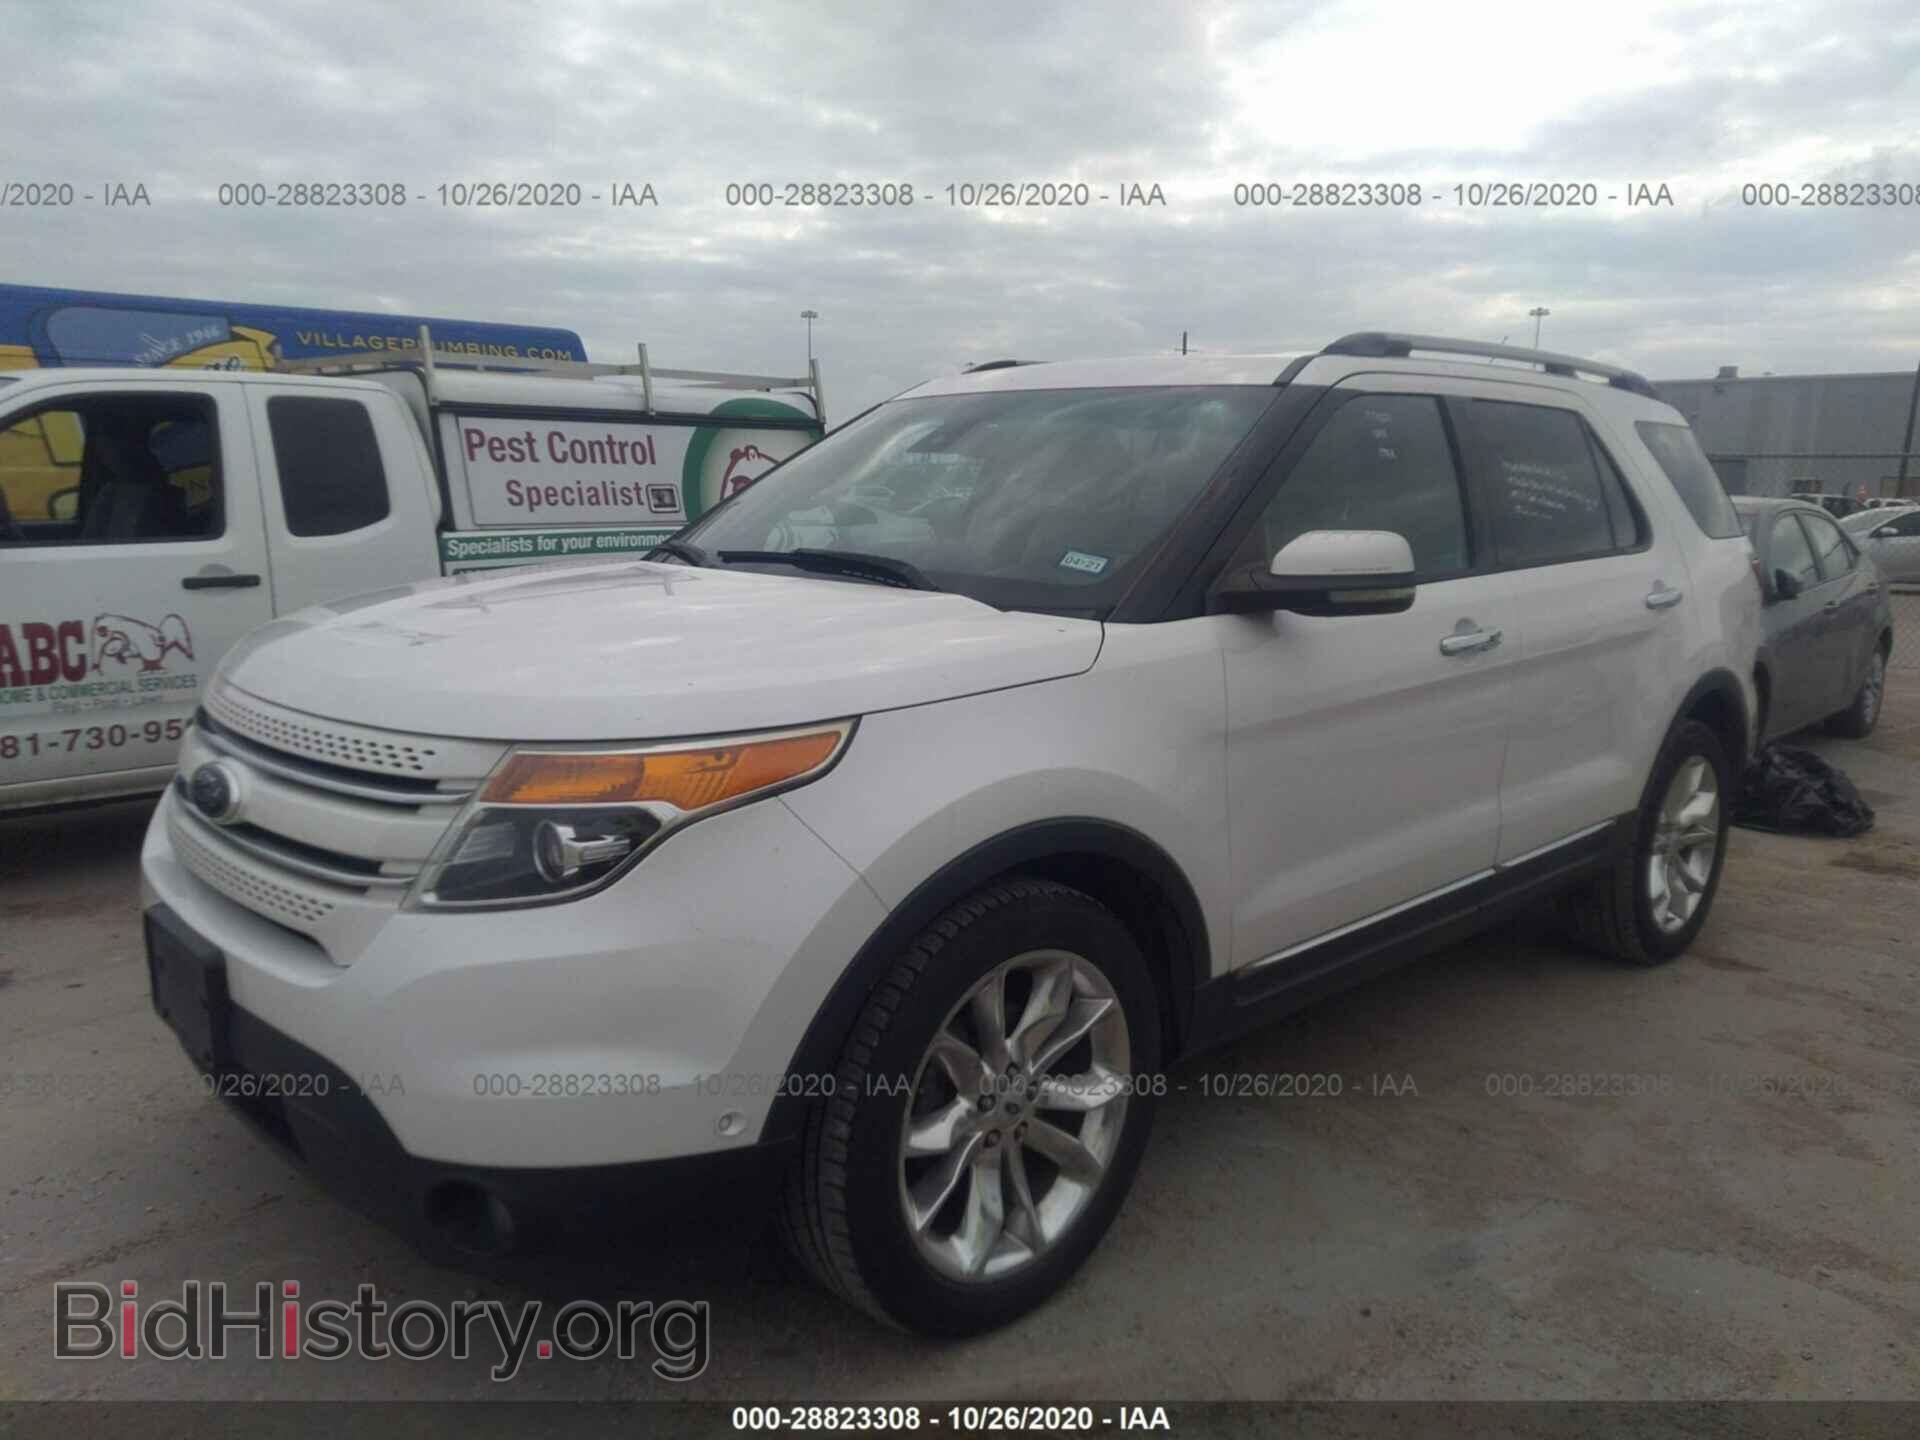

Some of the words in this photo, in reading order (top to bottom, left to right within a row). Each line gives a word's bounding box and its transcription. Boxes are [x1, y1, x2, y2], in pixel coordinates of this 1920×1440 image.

[464, 427, 540, 463] Pest
[546, 430, 657, 465] Control
[506, 479, 645, 512] Specialist
[448, 537, 534, 559] Specialists
[537, 535, 559, 551] for
[561, 536, 593, 553] your
[0, 620, 87, 688] ABC
[50, 680, 136, 701] COMMERCIAL
[138, 674, 197, 692] SERVICES
